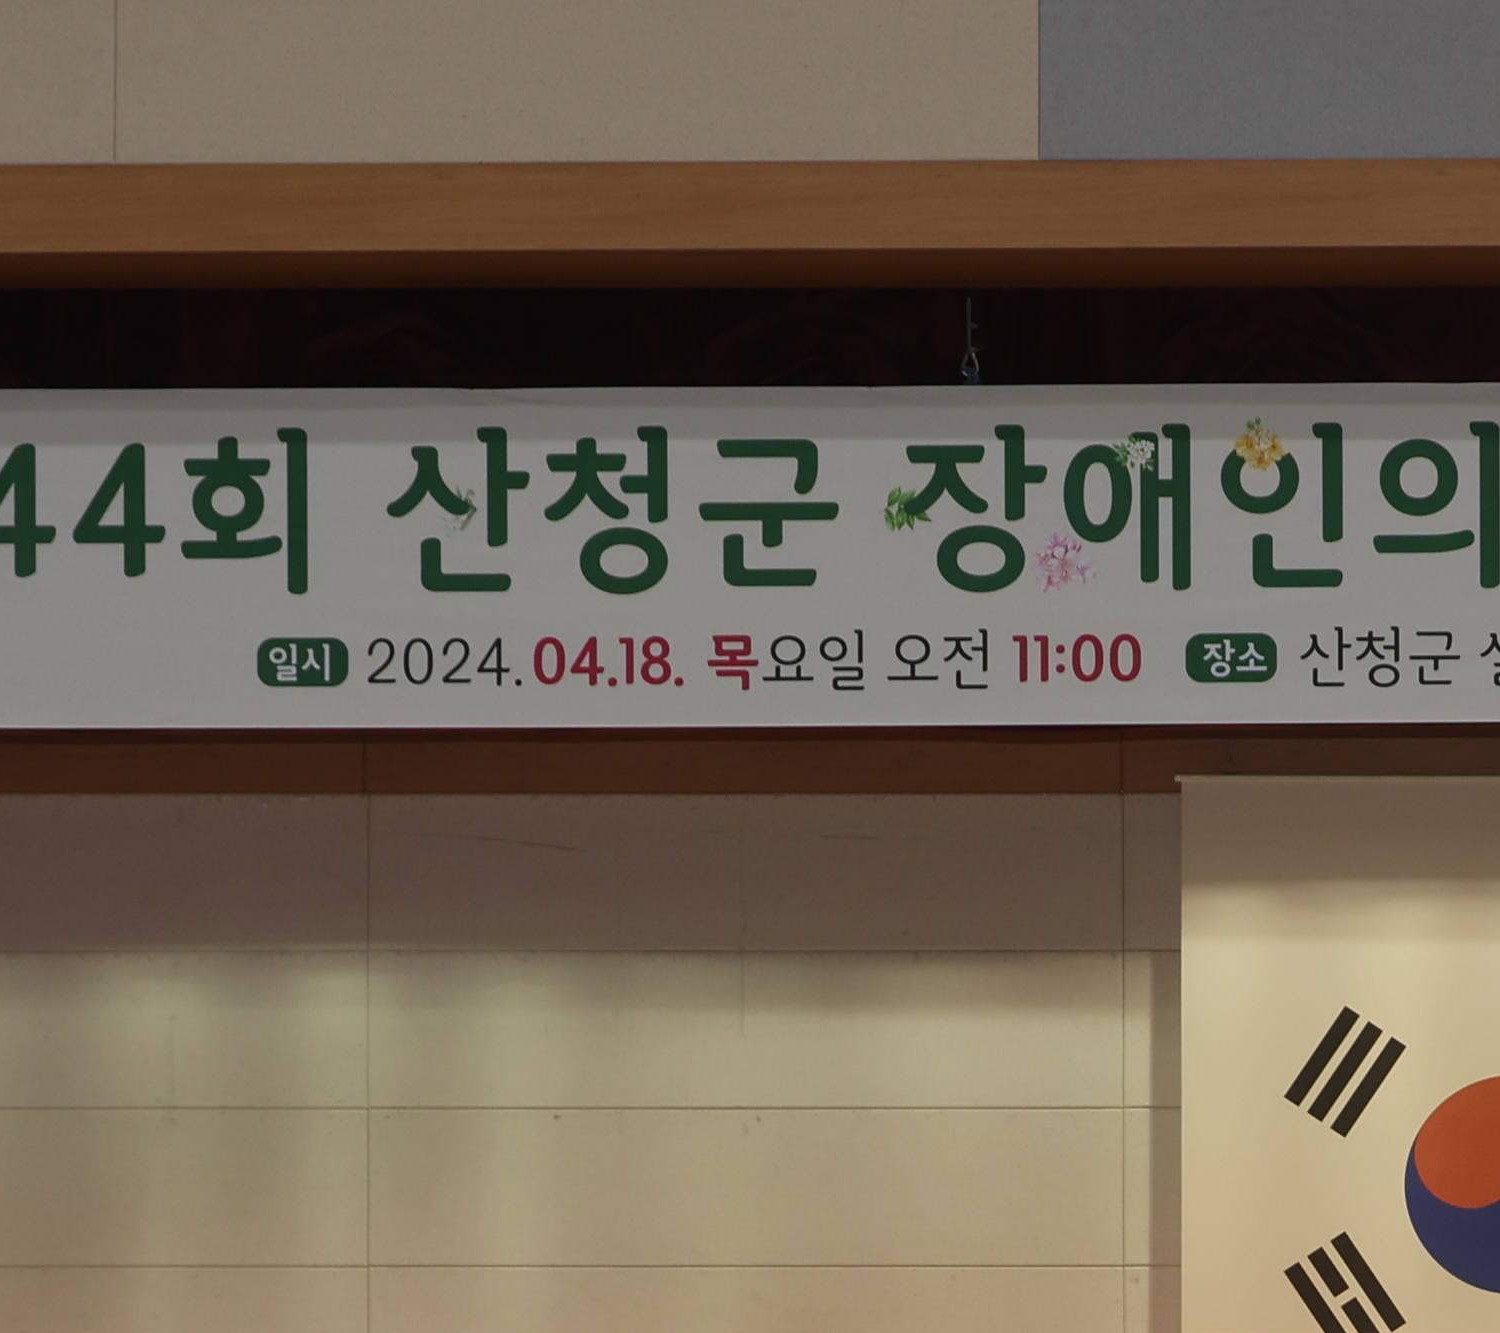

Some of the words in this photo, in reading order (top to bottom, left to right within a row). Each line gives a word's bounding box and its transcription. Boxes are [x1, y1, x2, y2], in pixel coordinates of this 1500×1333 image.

[385, 424, 841, 597] 산청군
[901, 420, 1500, 595] 장애인의
[266, 642, 338, 684] 일시
[706, 630, 866, 692] 목요일
[885, 629, 990, 690] 오전
[1011, 634, 1143, 684] 11:00
[1200, 638, 1269, 680] 장소
[1299, 626, 1461, 689] 산청군
